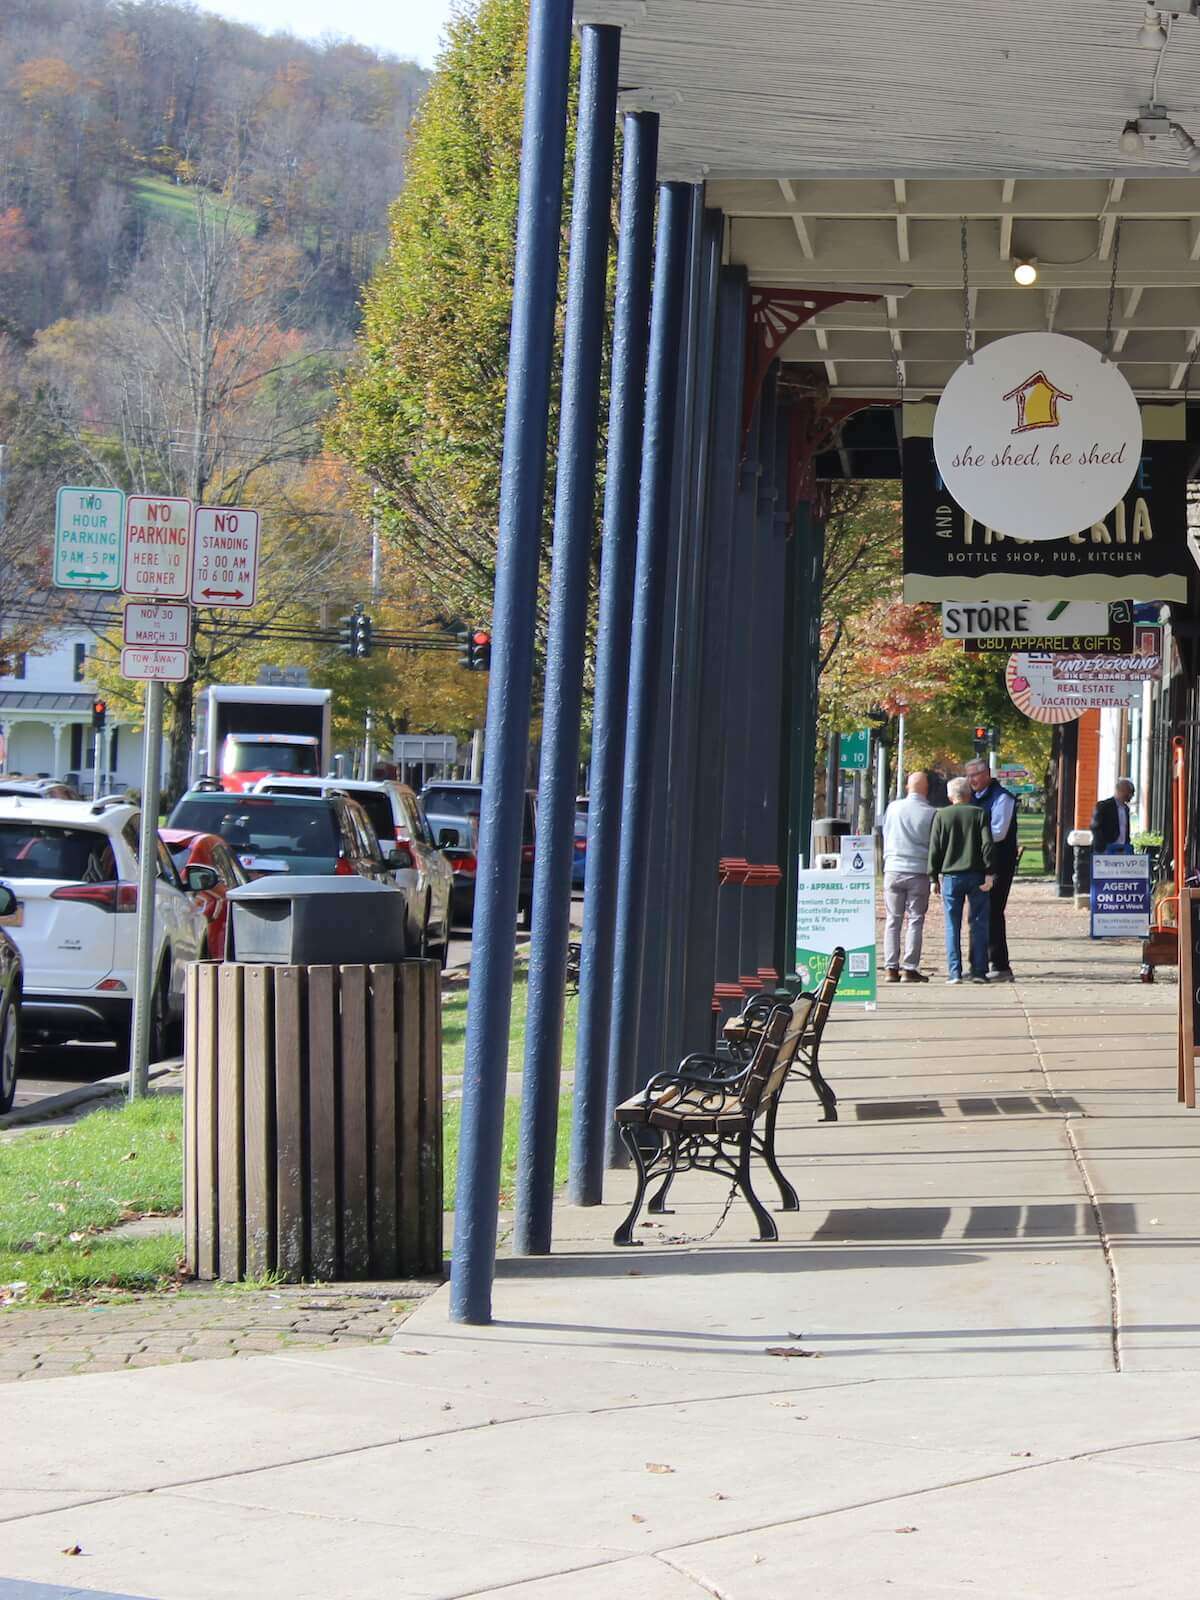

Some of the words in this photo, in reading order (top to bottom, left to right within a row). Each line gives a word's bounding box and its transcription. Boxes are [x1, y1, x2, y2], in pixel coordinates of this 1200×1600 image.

[952, 445, 984, 468] she
[1049, 443, 1072, 466] he
[1078, 442, 1126, 466] shed
[80, 496, 102, 510] TWO
[147, 504, 171, 522] NO
[72, 514, 108, 528] HOUR
[214, 514, 239, 533] NO
[936, 505, 953, 539] AND
[63, 531, 116, 545] PARKING
[129, 526, 187, 546] PARKING
[203, 536, 249, 550] STANDING
[61, 551, 67, 561] 9
[70, 552, 84, 563] AM
[92, 552, 98, 564] 5
[102, 553, 116, 565] PM
[133, 552, 160, 566] HERE
[168, 553, 180, 567] TO
[233, 557, 246, 568] AM
[947, 552, 998, 562] BOTTLE
[1006, 552, 1044, 563] SHOP,
[1053, 552, 1081, 563] PUB,
[1088, 552, 1142, 562] KITCHEN
[136, 571, 175, 585] CORNER
[198, 569, 208, 581] TO
[239, 571, 250, 583] AM
[141, 609, 159, 619] NOV
[161, 610, 174, 620] 30
[945, 606, 1029, 633] STORE
[136, 631, 166, 641] MARCH
[168, 632, 178, 641] 31
[977, 637, 1007, 650] CBD,
[1011, 637, 1069, 650] APPAREL
[1072, 637, 1081, 650] &
[1084, 637, 1121, 650] GIFTS
[132, 655, 149, 663] TOW
[153, 653, 177, 665] AWAY
[1055, 656, 1159, 672] UNDERGROUND
[143, 665, 167, 673] ZONE
[1057, 684, 1079, 693] REAL
[1082, 685, 1116, 694] ESTATE
[1041, 697, 1087, 706] VACATION
[1090, 698, 1130, 706] RENTALS
[1103, 882, 1139, 891] AGENT
[1097, 894, 1114, 903] ON
[1116, 894, 1145, 903] DUTY
